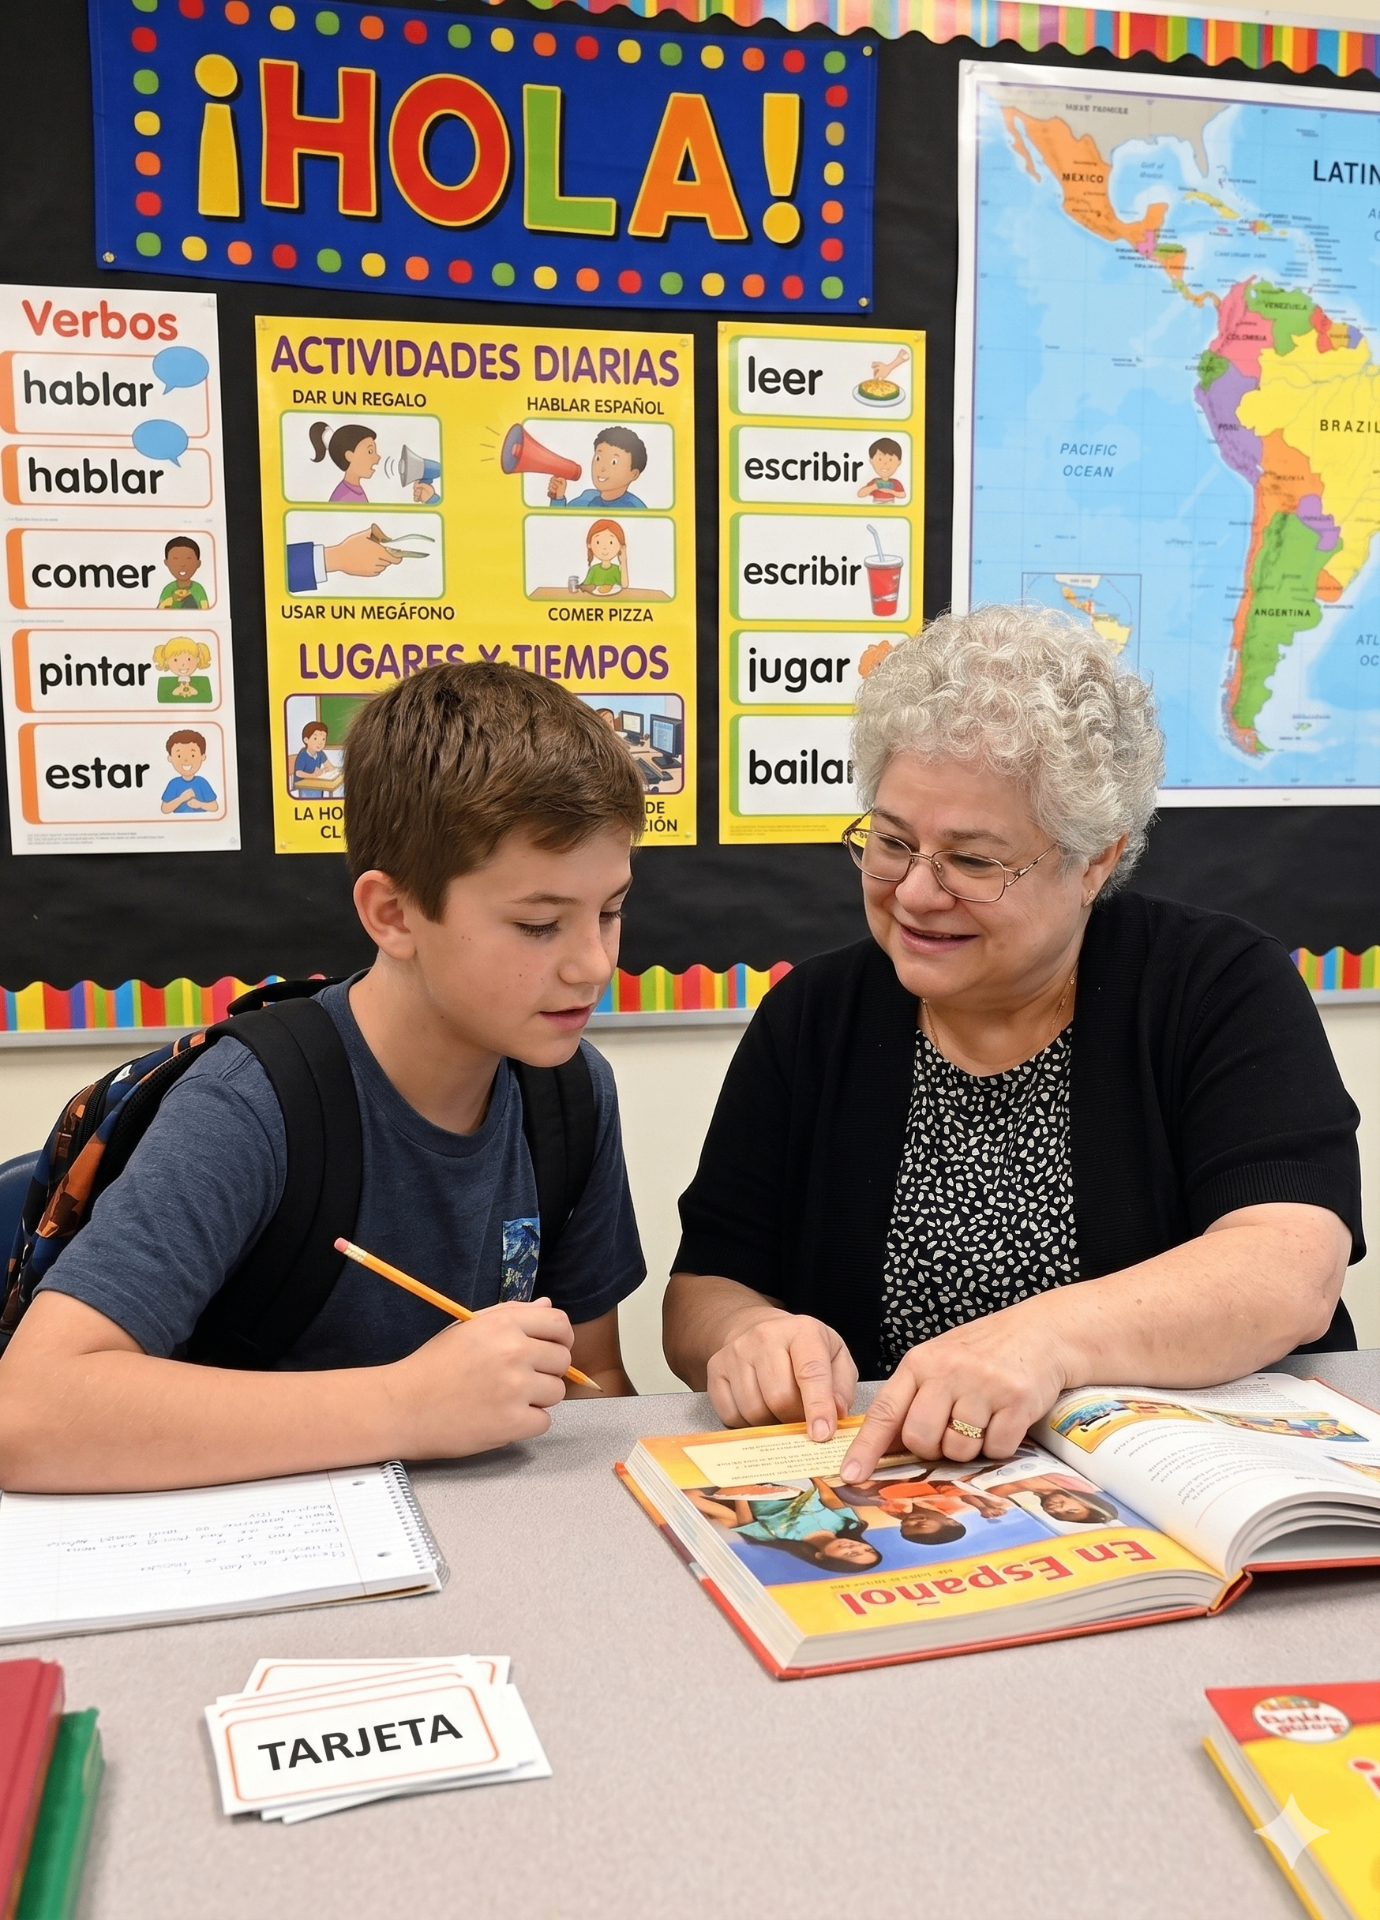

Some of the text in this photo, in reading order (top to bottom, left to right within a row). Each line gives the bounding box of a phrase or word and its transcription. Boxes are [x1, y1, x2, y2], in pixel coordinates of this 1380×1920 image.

[195, 54, 801, 244] ¡HOLA!
[1062, 173, 1104, 183] MEXICO
[1313, 159, 1380, 185] LATIN
[22, 299, 179, 341] Verbos
[271, 335, 680, 387] ACTIVIDADES DIARIAS
[748, 355, 823, 395] leer
[23, 369, 154, 407] hablar
[292, 389, 427, 408] DAR UN REGALO
[527, 397, 665, 415] HABLAR ESPAÑOL
[1320, 419, 1380, 433] BRAZIL
[1060, 443, 1117, 456] PACIFIC
[28, 457, 164, 494] hablar
[744, 451, 863, 483] escribir
[1063, 465, 1113, 477] OCEAN
[31, 563, 156, 589] comer
[744, 555, 862, 586] escribir
[281, 602, 455, 620] USAR UN MEGÁFONO
[548, 607, 654, 622] COMER PIZZA
[39, 653, 151, 696] pintar
[512, 644, 669, 680] TIEMPOS
[749, 647, 850, 692] jugar
[45, 757, 150, 789] estar
[294, 807, 314, 820] LA
[645, 801, 665, 814] DE
[644, 816, 677, 832] IÓN
[1075, 1541, 1157, 1562] En
[838, 1555, 1073, 1616] Español
[257, 1714, 463, 1771] TARJETA
